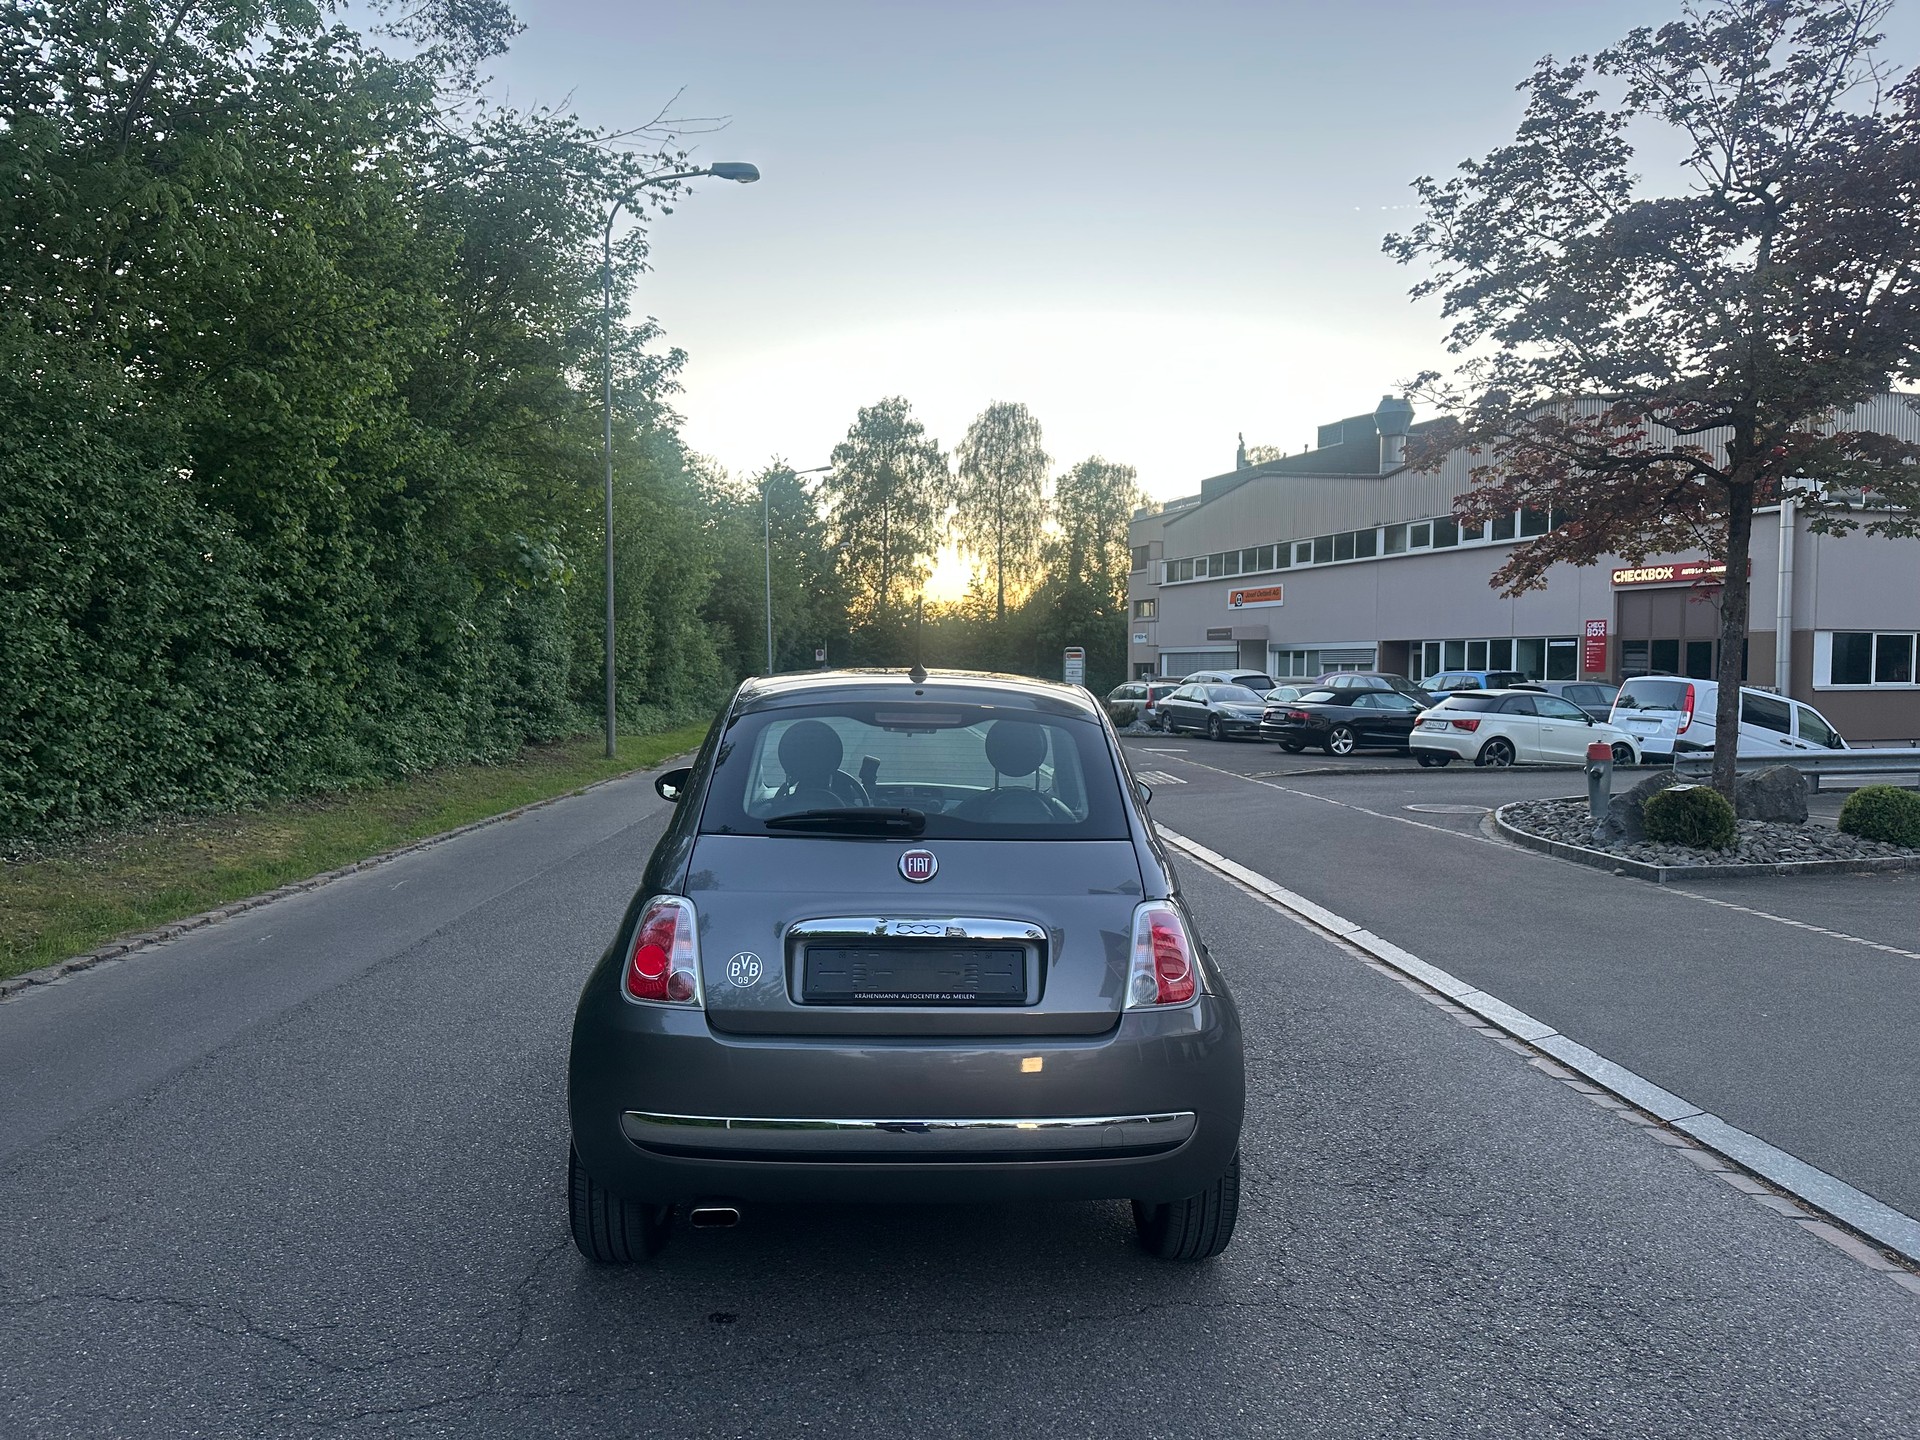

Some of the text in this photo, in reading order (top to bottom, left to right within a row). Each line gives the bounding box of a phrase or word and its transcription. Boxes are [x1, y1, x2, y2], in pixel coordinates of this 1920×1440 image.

[1613, 566, 1674, 583] CHECKBOX
[1586, 628, 1605, 637] BOX
[908, 857, 930, 873] FIAT
[896, 922, 941, 935] 500
[731, 955, 759, 977] BVB
[737, 976, 749, 984] 09
